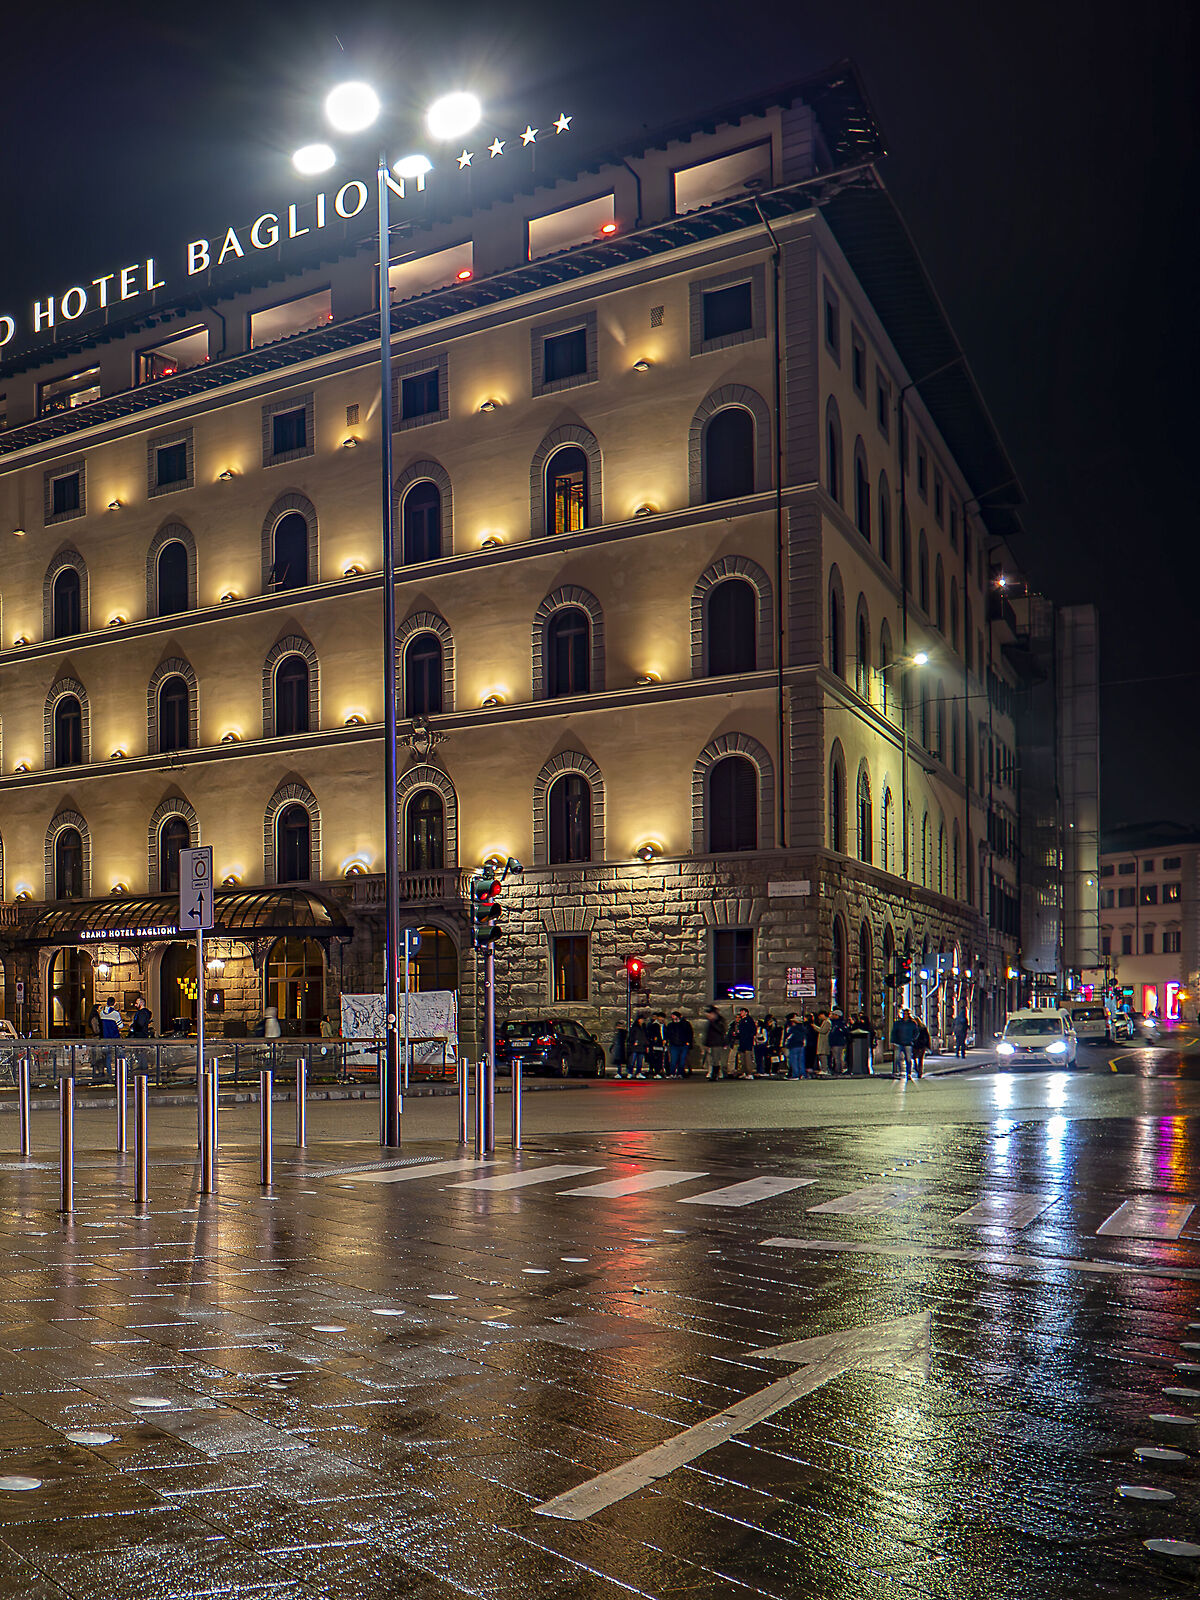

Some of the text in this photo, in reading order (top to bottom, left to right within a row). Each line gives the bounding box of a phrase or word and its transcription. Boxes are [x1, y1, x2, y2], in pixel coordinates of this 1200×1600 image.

[33, 258, 166, 333] HOTEL
[80, 926, 177, 939] GRAND HOTEL BAGLIONI
